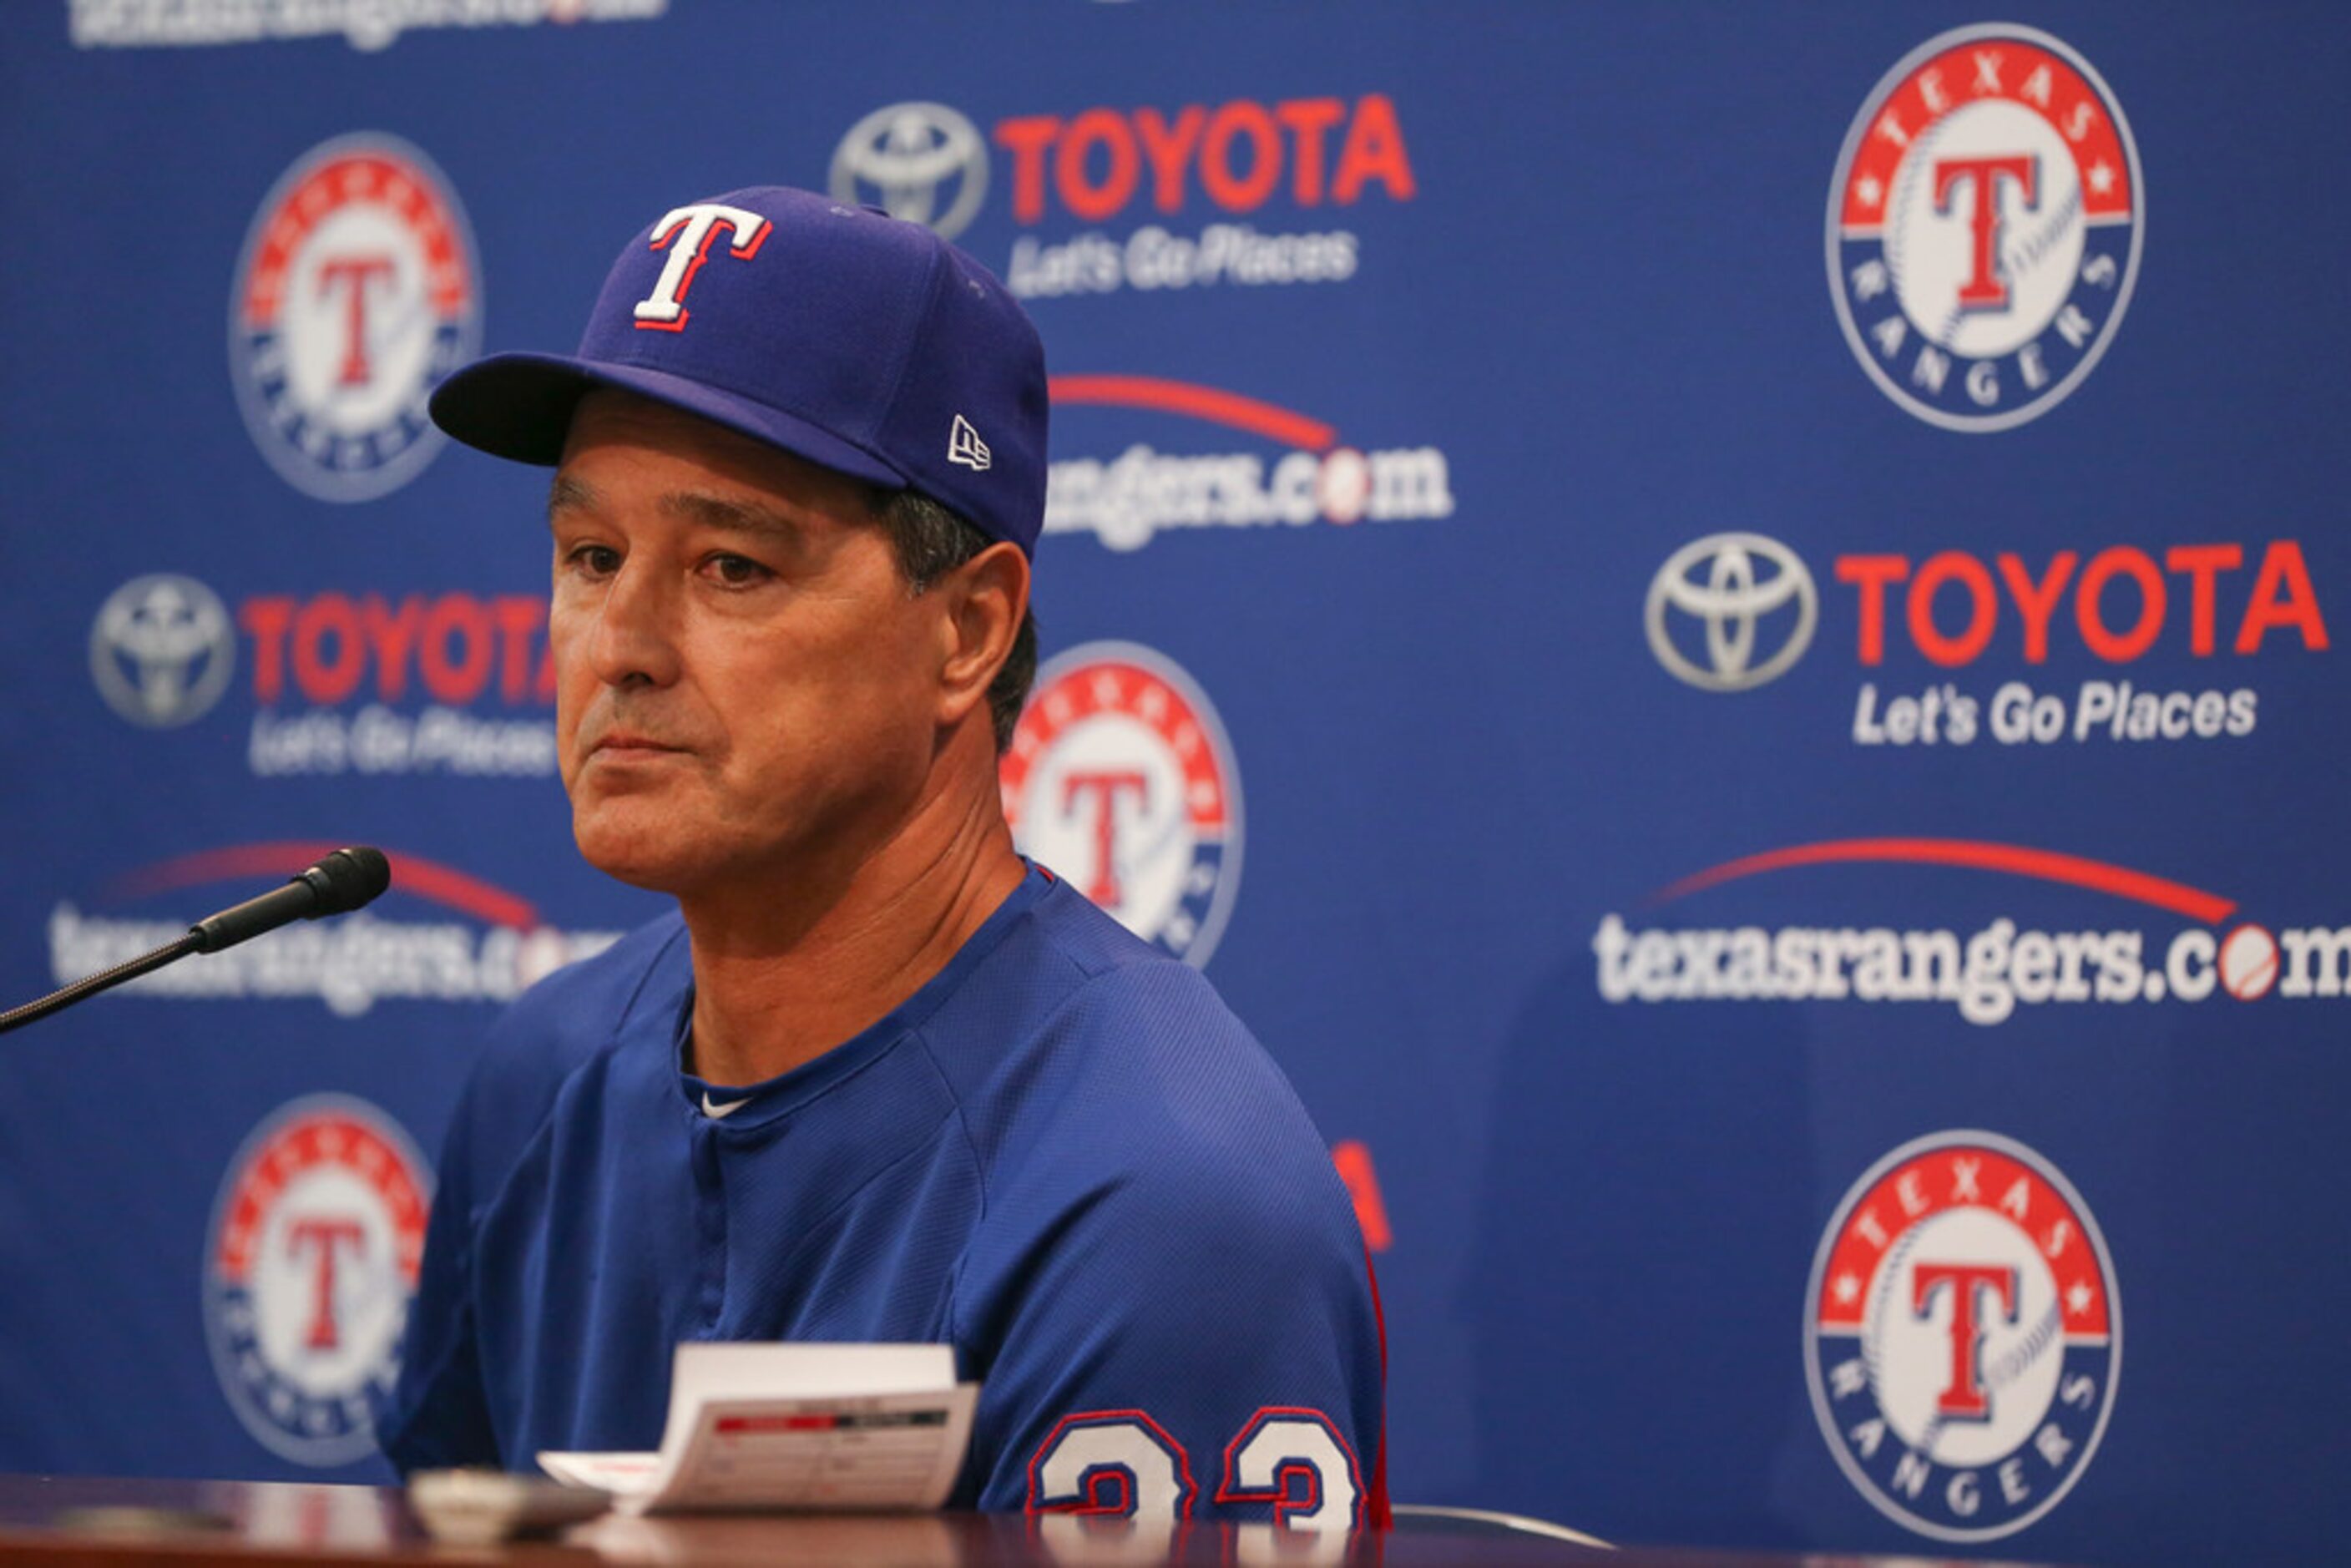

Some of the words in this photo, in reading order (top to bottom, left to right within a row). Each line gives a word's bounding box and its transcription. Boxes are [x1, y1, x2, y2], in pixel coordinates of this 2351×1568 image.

[993, 94, 1417, 224] TOYOTA
[1878, 48, 2096, 149] TEXAS
[633, 203, 773, 332] T
[1933, 152, 2042, 312] T
[314, 248, 397, 387] T
[1851, 251, 2116, 407] RANGERS
[1835, 541, 2329, 666] TOYOTA
[1853, 683, 1979, 746] Let's
[1989, 680, 2066, 745] Go
[2073, 679, 2257, 741] Places
[1061, 770, 1148, 908] T
[1853, 1156, 2074, 1258] TEXAS
[285, 1217, 366, 1351] T
[1911, 1262, 2021, 1423] T
[1830, 1357, 2096, 1516] RANGERS
